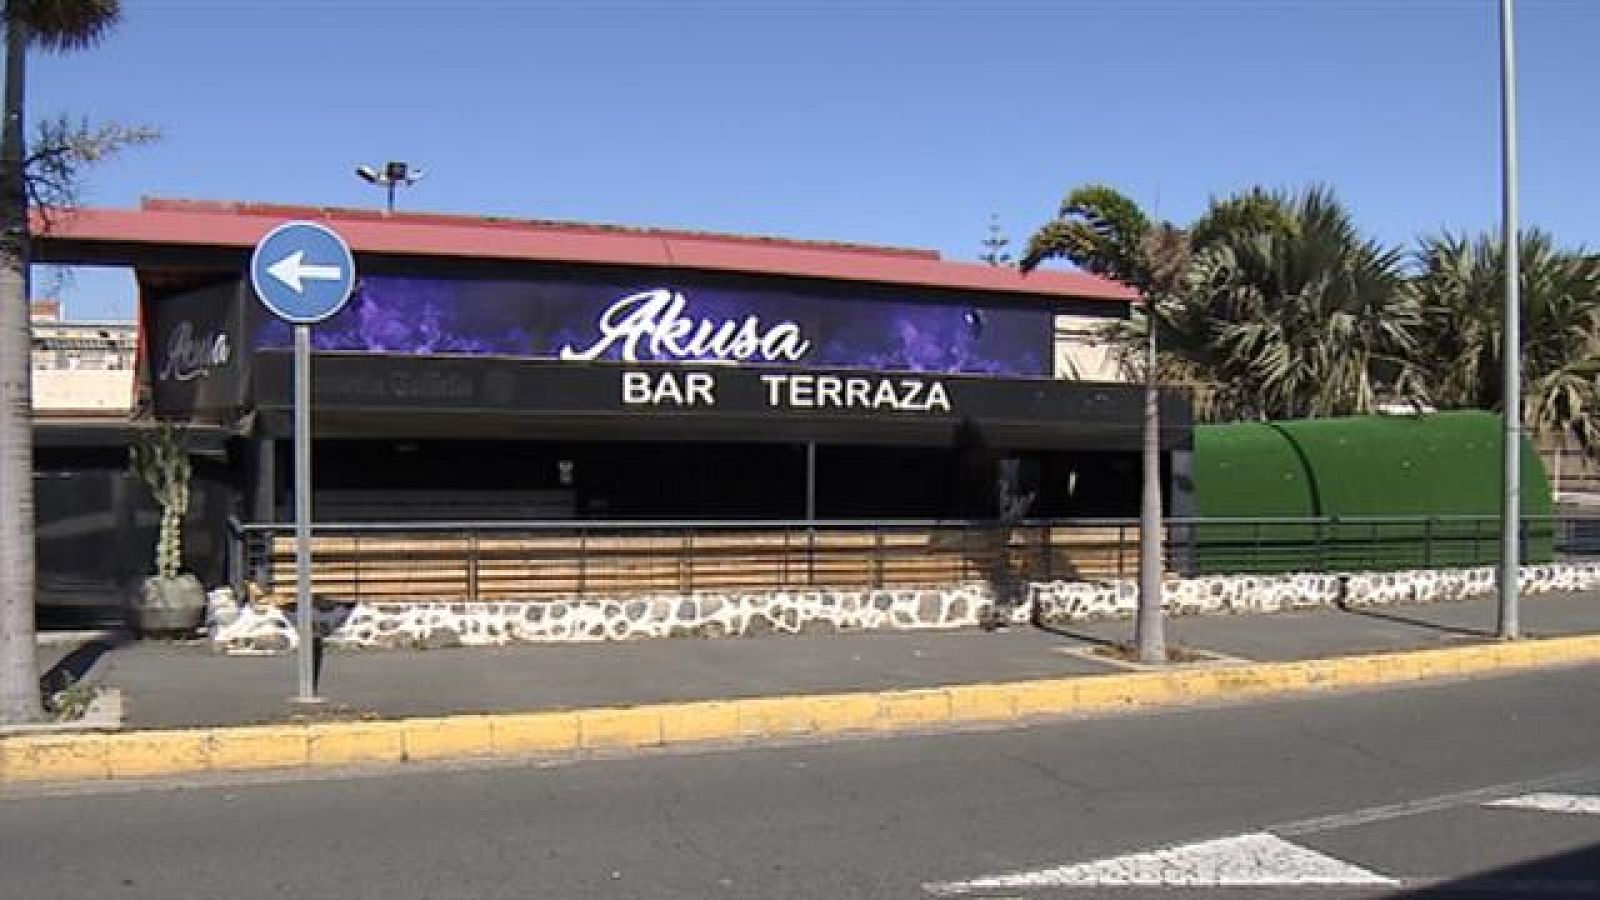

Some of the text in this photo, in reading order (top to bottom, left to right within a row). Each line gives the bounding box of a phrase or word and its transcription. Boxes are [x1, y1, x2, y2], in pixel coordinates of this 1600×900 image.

[560, 289, 810, 361] Akusa
[622, 372, 951, 412] BAR TERRAZA
